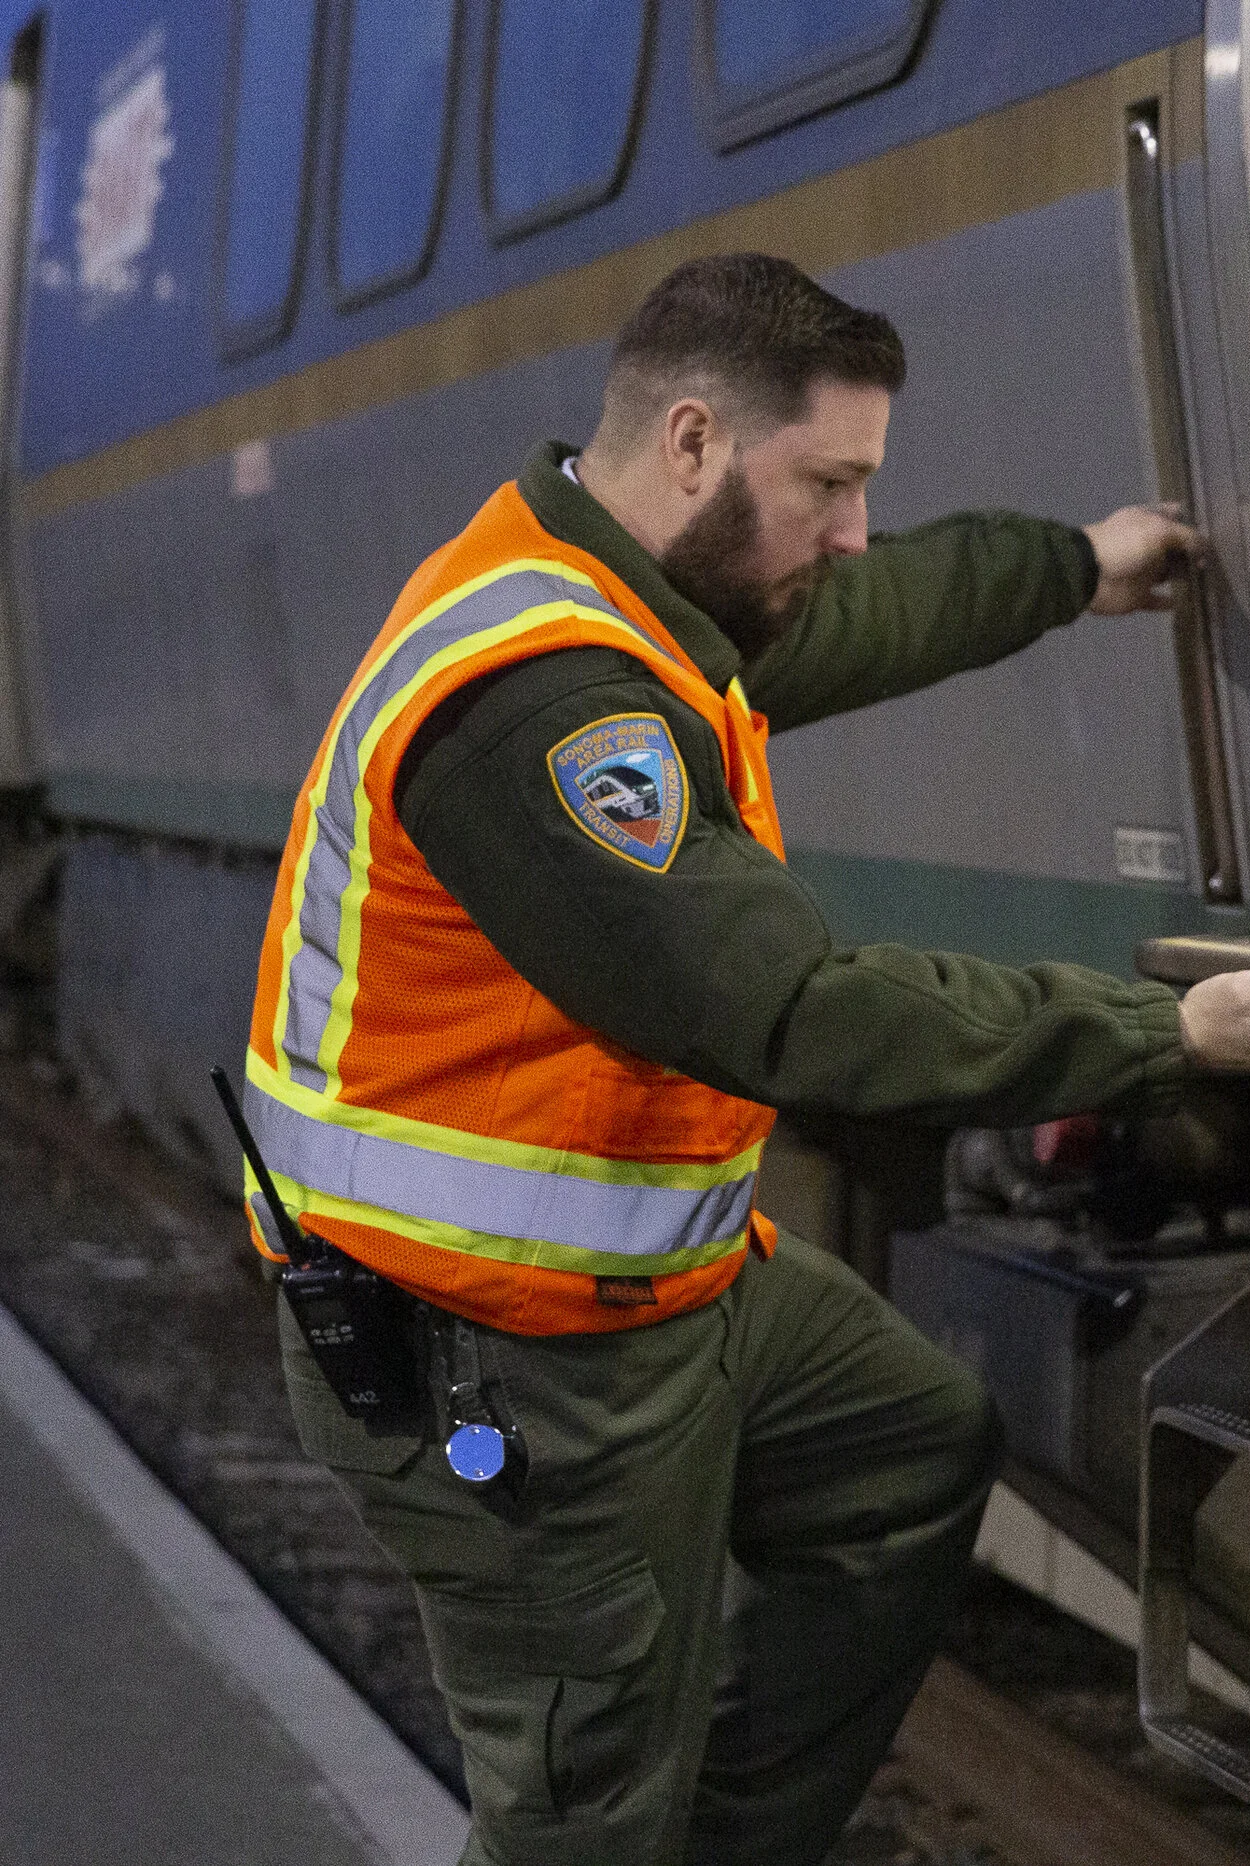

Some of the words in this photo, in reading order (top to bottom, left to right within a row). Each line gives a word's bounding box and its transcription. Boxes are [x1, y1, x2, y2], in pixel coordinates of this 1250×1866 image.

[576, 742, 615, 769] AREA
[616, 735, 649, 750] RAIL
[579, 801, 630, 847] TRANSIT
